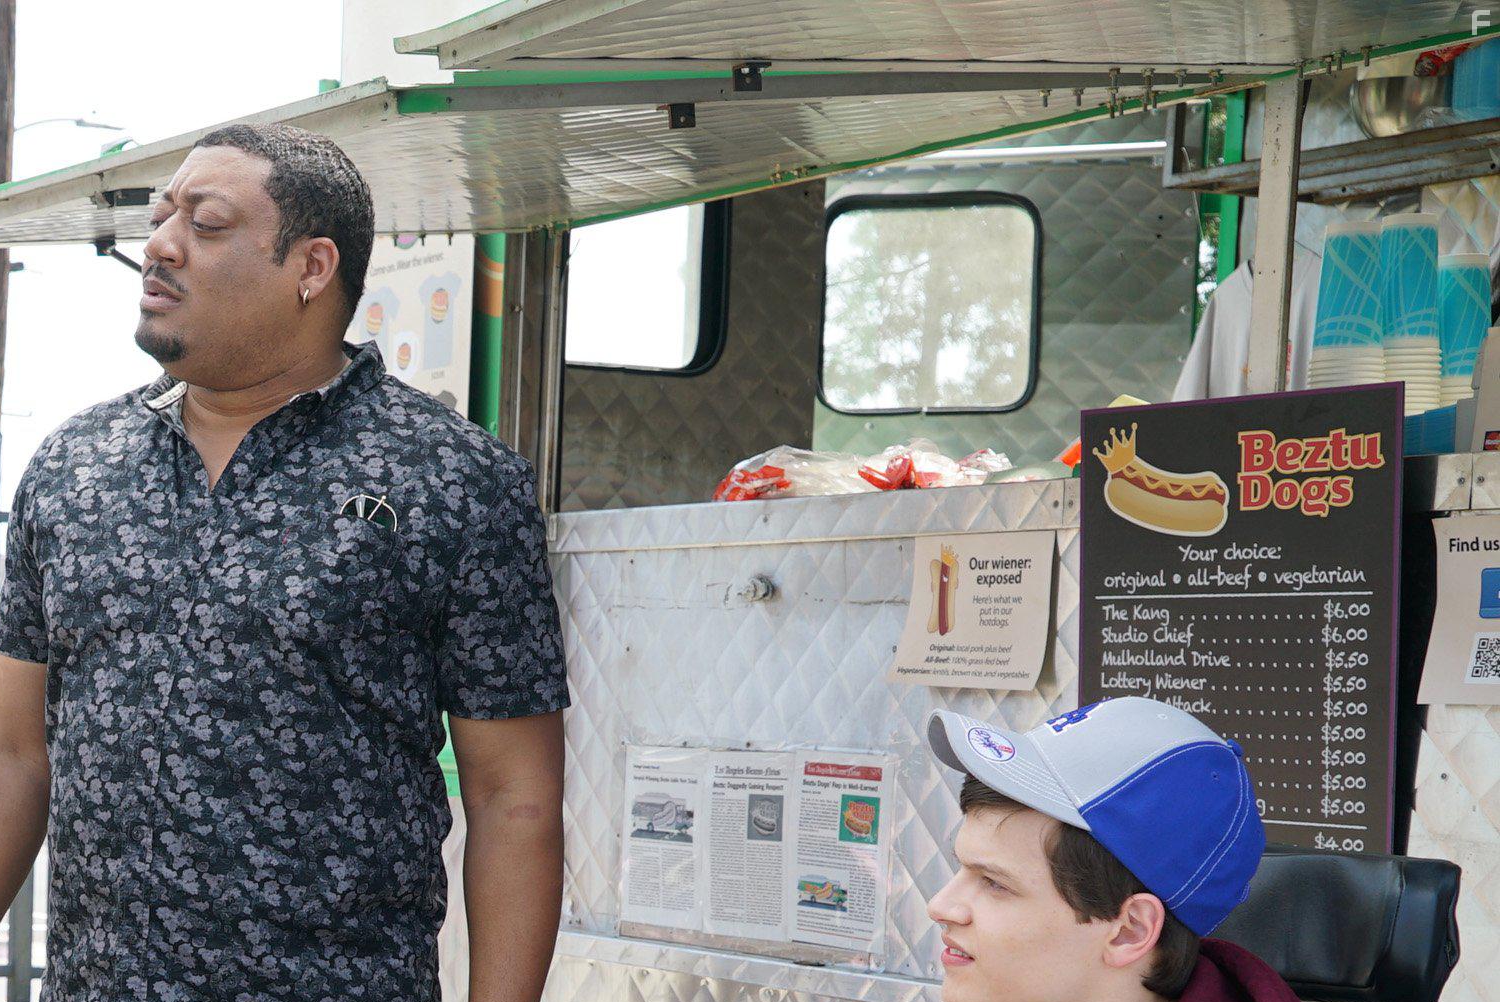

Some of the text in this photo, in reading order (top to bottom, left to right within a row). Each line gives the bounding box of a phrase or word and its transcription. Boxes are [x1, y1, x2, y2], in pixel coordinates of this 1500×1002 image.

[1237, 428, 1385, 475] Beztu
[1237, 471, 1354, 518] Dogs
[1178, 542, 1282, 562] Your choice:
[1449, 538, 1500, 553] Find us
[969, 556, 1032, 571] Our wiener:
[976, 571, 1022, 588] exposed
[1104, 566, 1367, 591] original all-beef vegetarian
[972, 595, 992, 604] Here's
[993, 595, 1011, 604] what
[979, 606, 991, 616] put
[992, 607, 1000, 615] in
[1102, 599, 1371, 627] The Kang $6.00
[1101, 623, 1368, 648] Studio Chief $6.00
[998, 645, 1013, 654] beef
[1101, 648, 1369, 672] Mulholland Drive $5.50
[1101, 671, 1152, 695] Lottery
[1155, 672, 1207, 691] Wiener
[1322, 673, 1367, 696] $5.50
[1322, 697, 1368, 720] $5.00
[1321, 721, 1366, 745] $5.00
[1321, 746, 1366, 770] $5.00
[1321, 771, 1367, 794] $5.00
[1320, 795, 1366, 819] $5.00
[1314, 831, 1364, 852] $4.00
